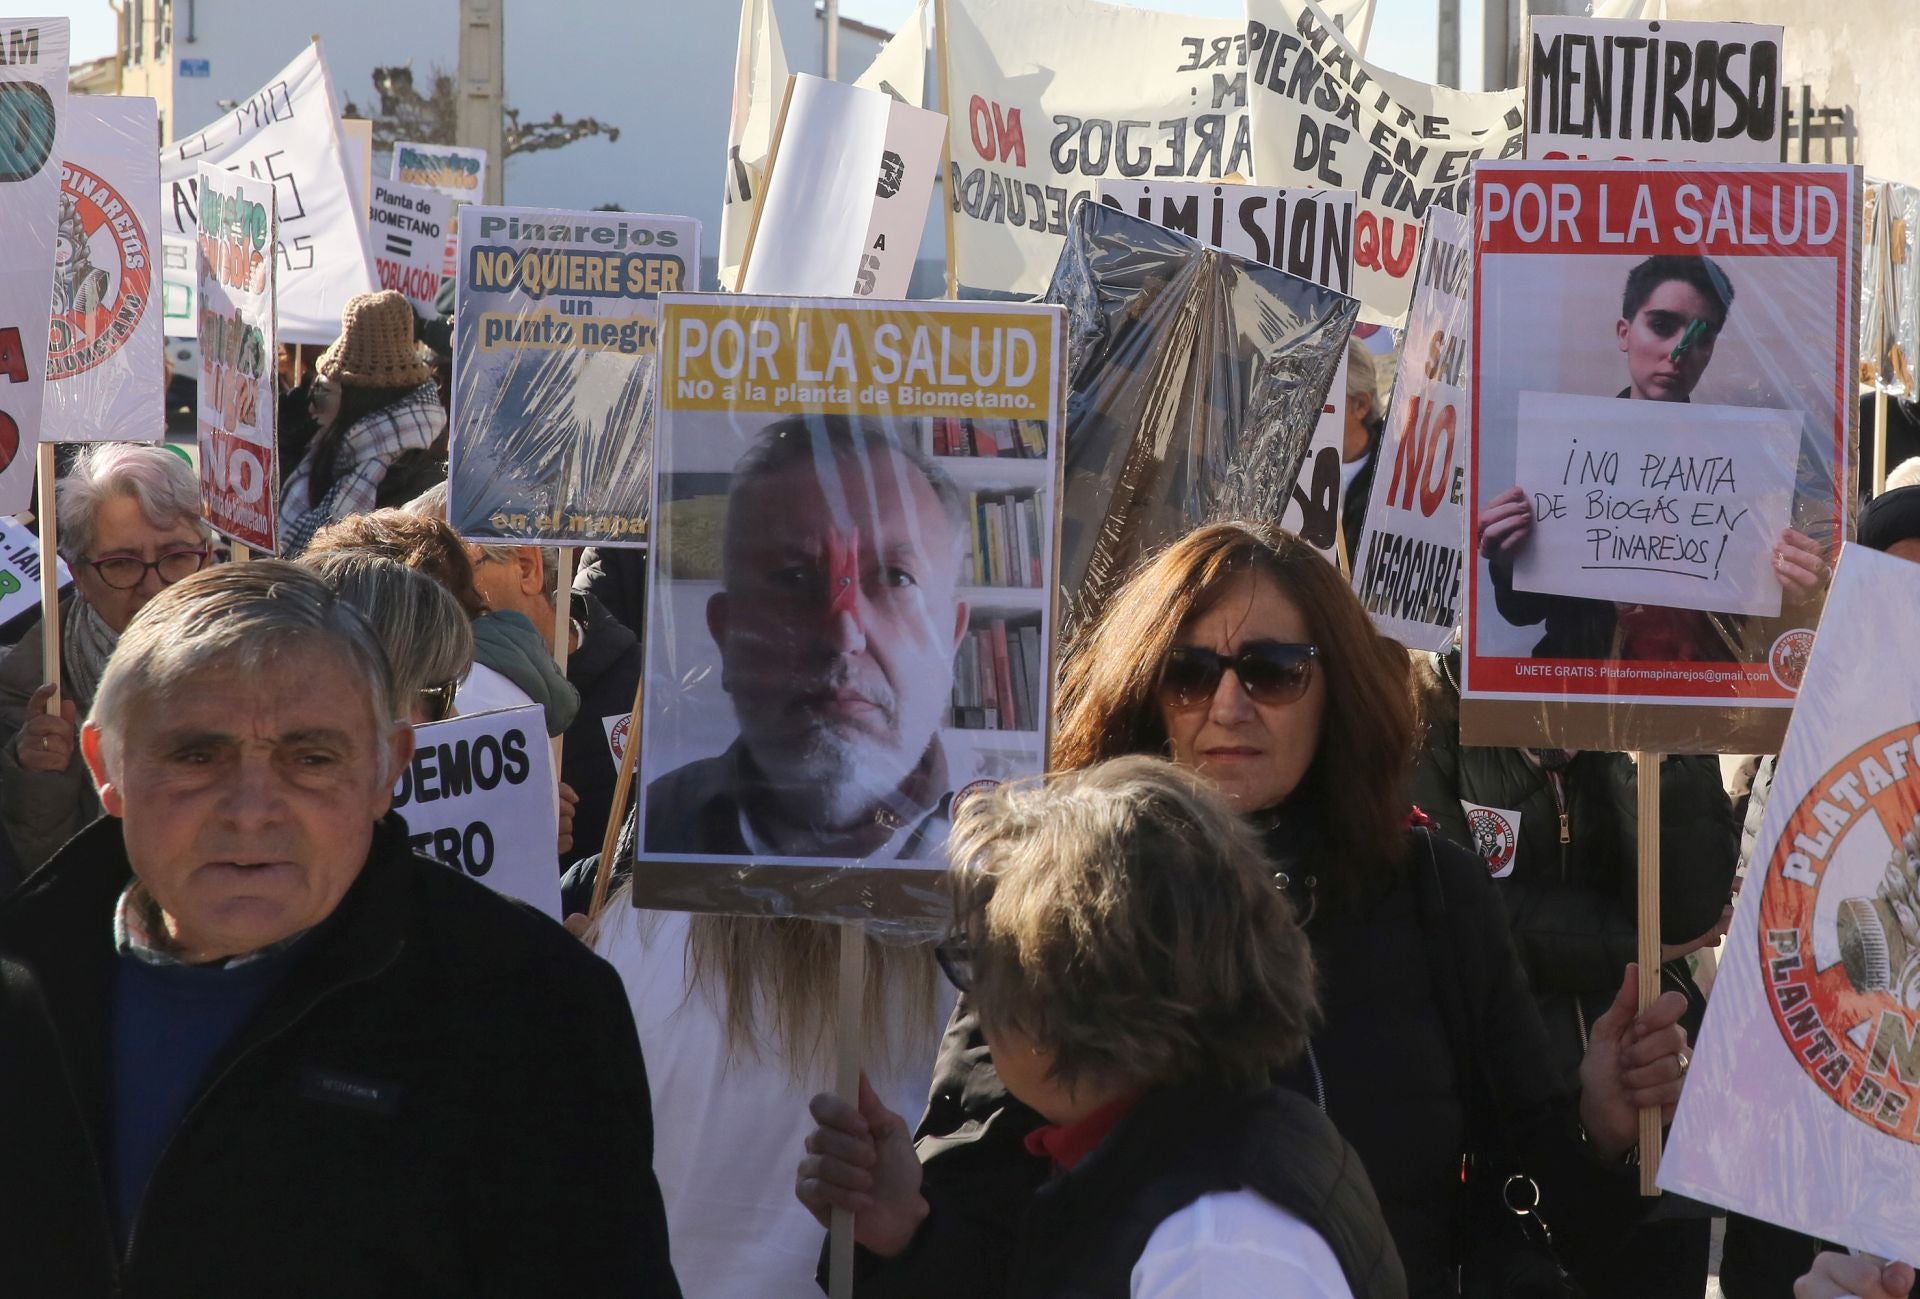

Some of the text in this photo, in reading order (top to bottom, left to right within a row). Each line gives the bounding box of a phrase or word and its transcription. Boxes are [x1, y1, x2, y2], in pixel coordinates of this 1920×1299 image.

[1248, 19, 1360, 134] PIENSA
[1368, 118, 1429, 178] EN
[1530, 21, 1778, 143] MENTIROSO
[1293, 113, 1351, 188] DE
[375, 186, 431, 215] Planta de
[1481, 181, 1839, 247] POR LA SALUD
[479, 216, 679, 250] Pinarejos
[1354, 209, 1424, 278] QU
[374, 257, 439, 302] POBLACIÓN
[475, 250, 512, 287] NO
[522, 252, 621, 295] QUIERE
[628, 257, 681, 293] SER
[559, 299, 593, 317] un
[484, 314, 575, 348] punto
[676, 317, 1038, 388] POR LA SALUD
[676, 379, 1036, 409] NO a la planta de Biometano.
[200, 432, 265, 504] NO
[1385, 394, 1457, 518] NO
[1640, 453, 1736, 495] PLANTA
[491, 508, 648, 540] en el mapa
[1534, 492, 1567, 522] DE
[1691, 501, 1749, 532] EN
[1515, 662, 1769, 683] ÚNETE GRATIS: Plataformapinarejos@gmail.com
[1781, 736, 1920, 889] PLATAF
[1765, 927, 1909, 1131] PLANTA DE
